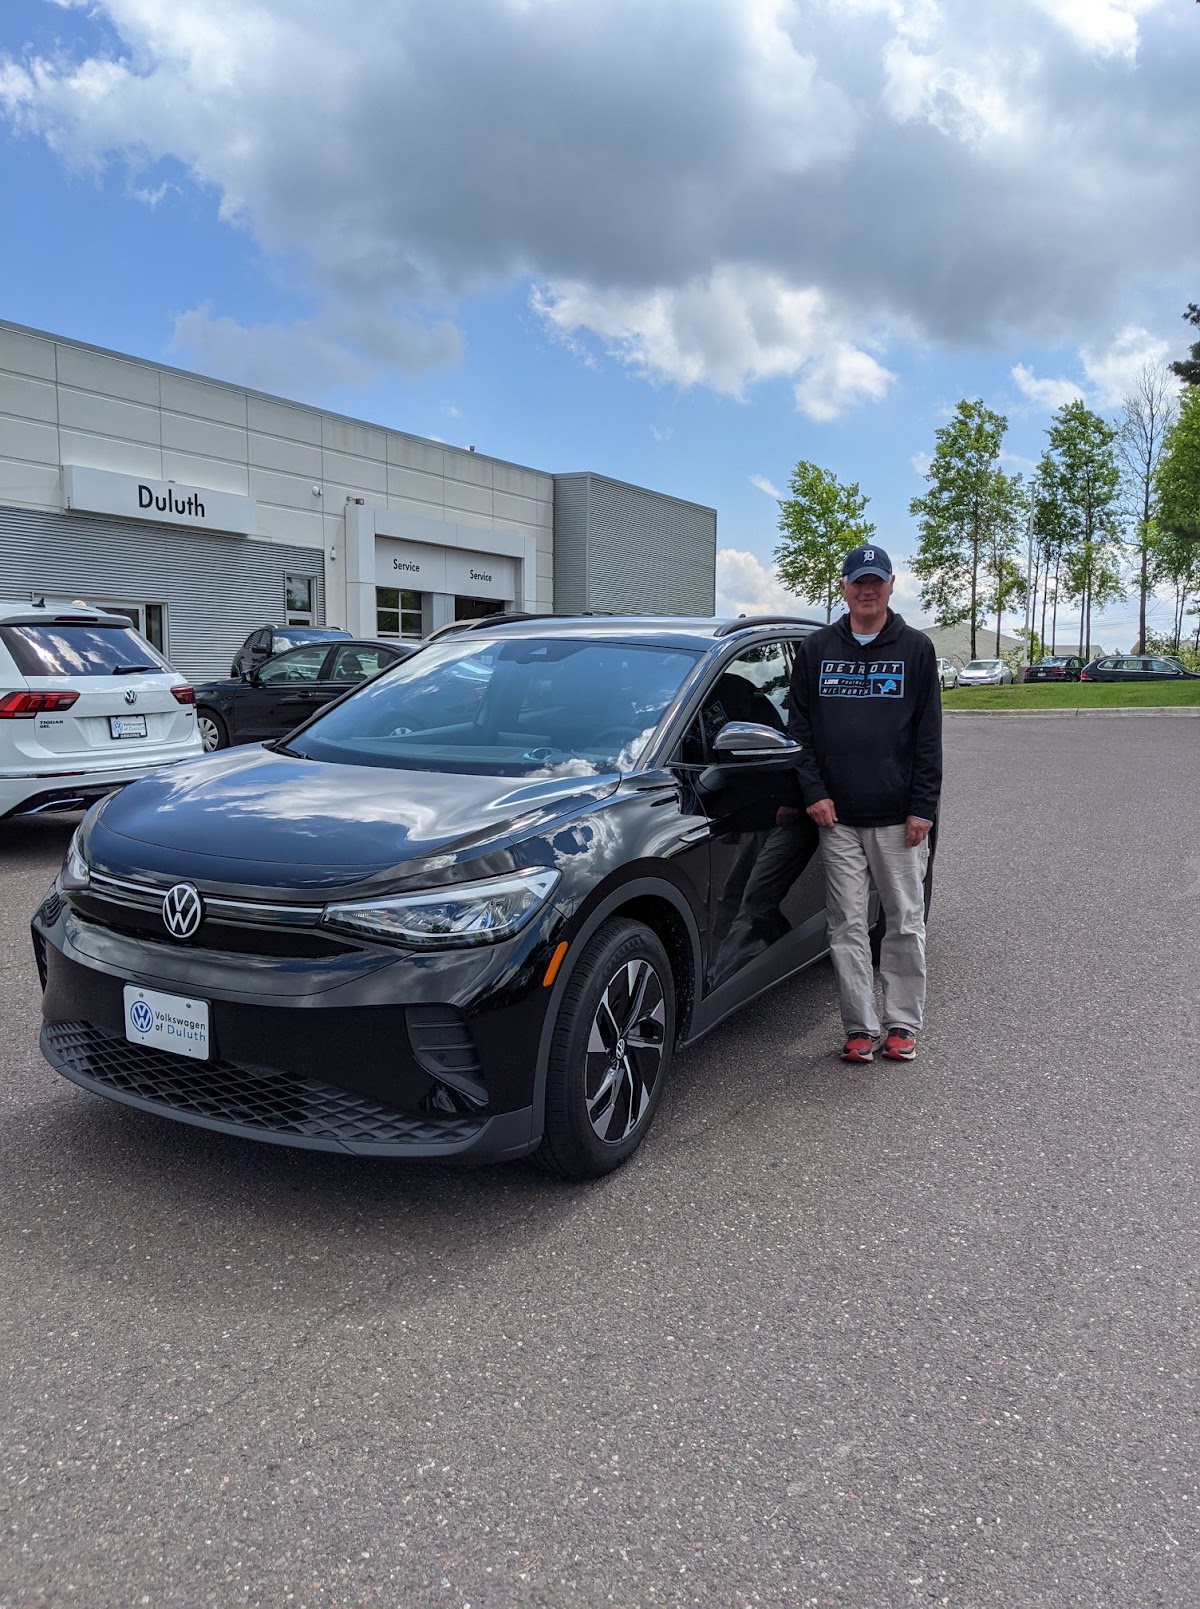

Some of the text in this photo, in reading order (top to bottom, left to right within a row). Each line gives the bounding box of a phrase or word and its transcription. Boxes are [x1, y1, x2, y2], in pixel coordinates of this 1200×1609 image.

[138, 484, 205, 518] Duluth
[862, 550, 875, 563] D
[393, 558, 420, 573] Service
[469, 569, 493, 582] Service
[825, 663, 900, 674] DETROIT
[155, 1011, 206, 1030] Volkswagen
[155, 1023, 206, 1042] of Duluth
